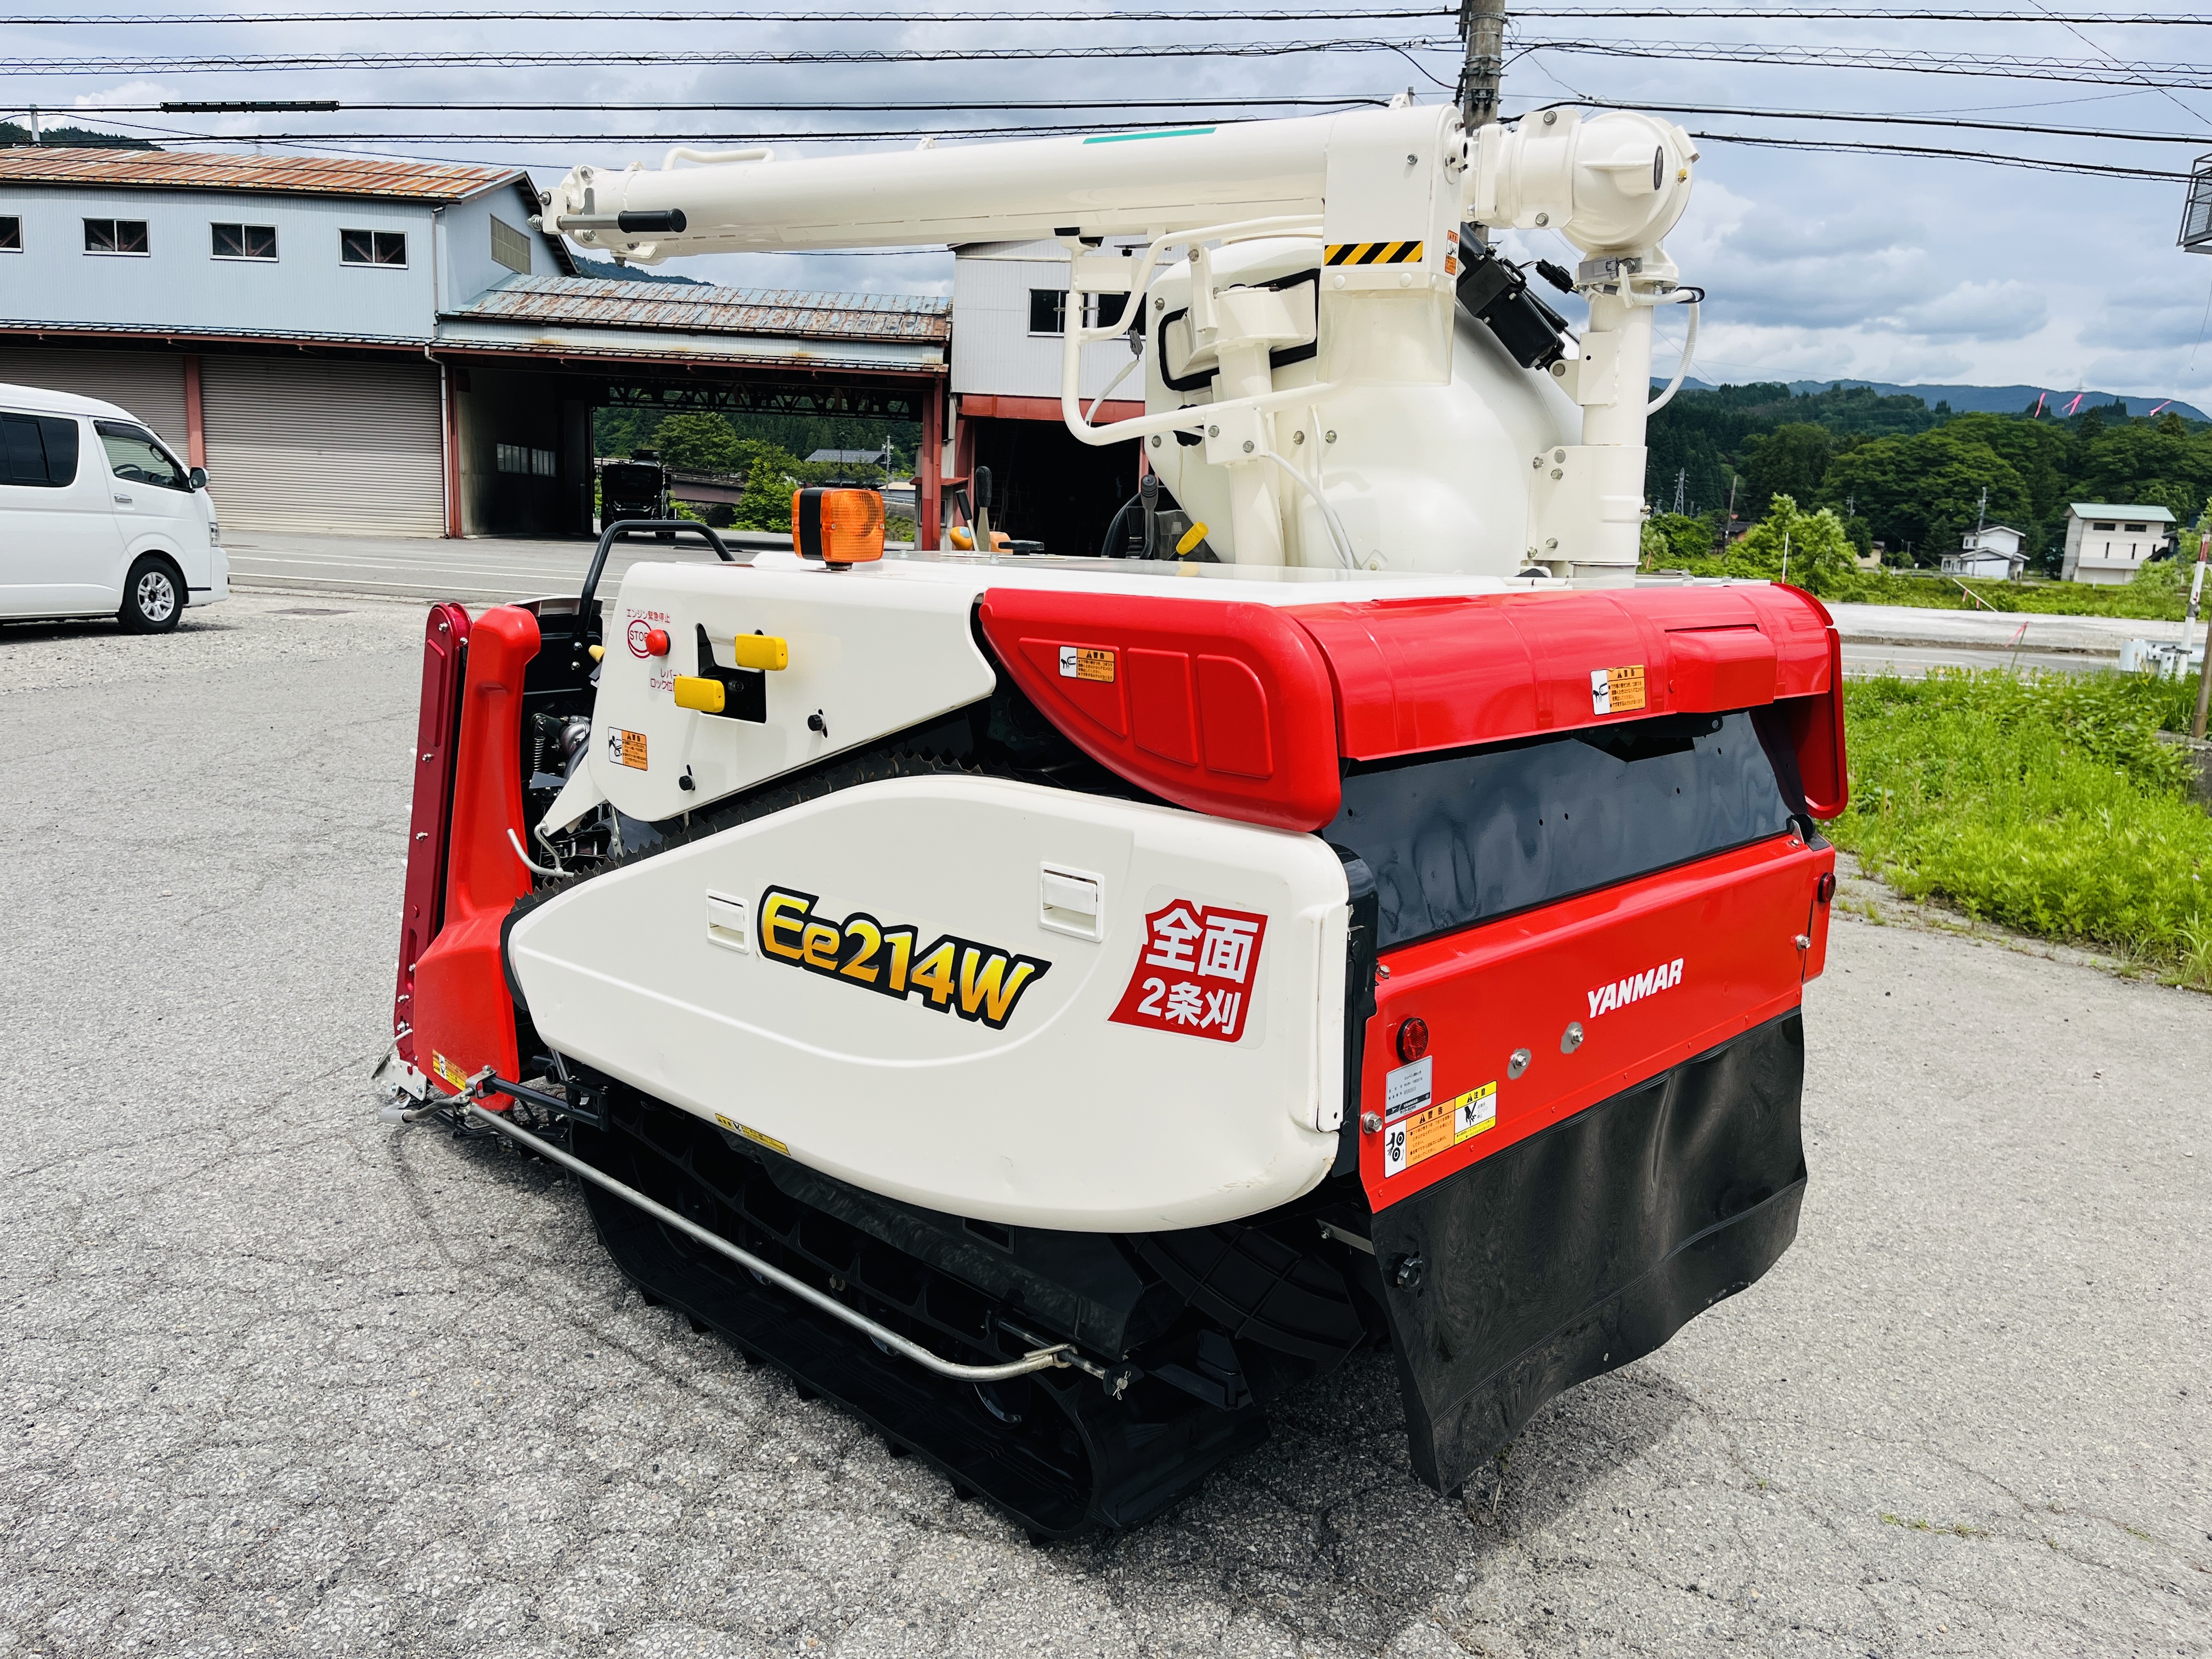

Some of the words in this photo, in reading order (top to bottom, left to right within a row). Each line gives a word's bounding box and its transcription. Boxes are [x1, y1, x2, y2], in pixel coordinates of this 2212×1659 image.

[627, 609, 670, 623] エンジン緊急停止
[760, 890, 1035, 1023] Ee214W
[1146, 907, 1260, 984] 全面
[1137, 977, 1242, 1035] 2条刈
[1587, 958, 1684, 1019] YANMAR
